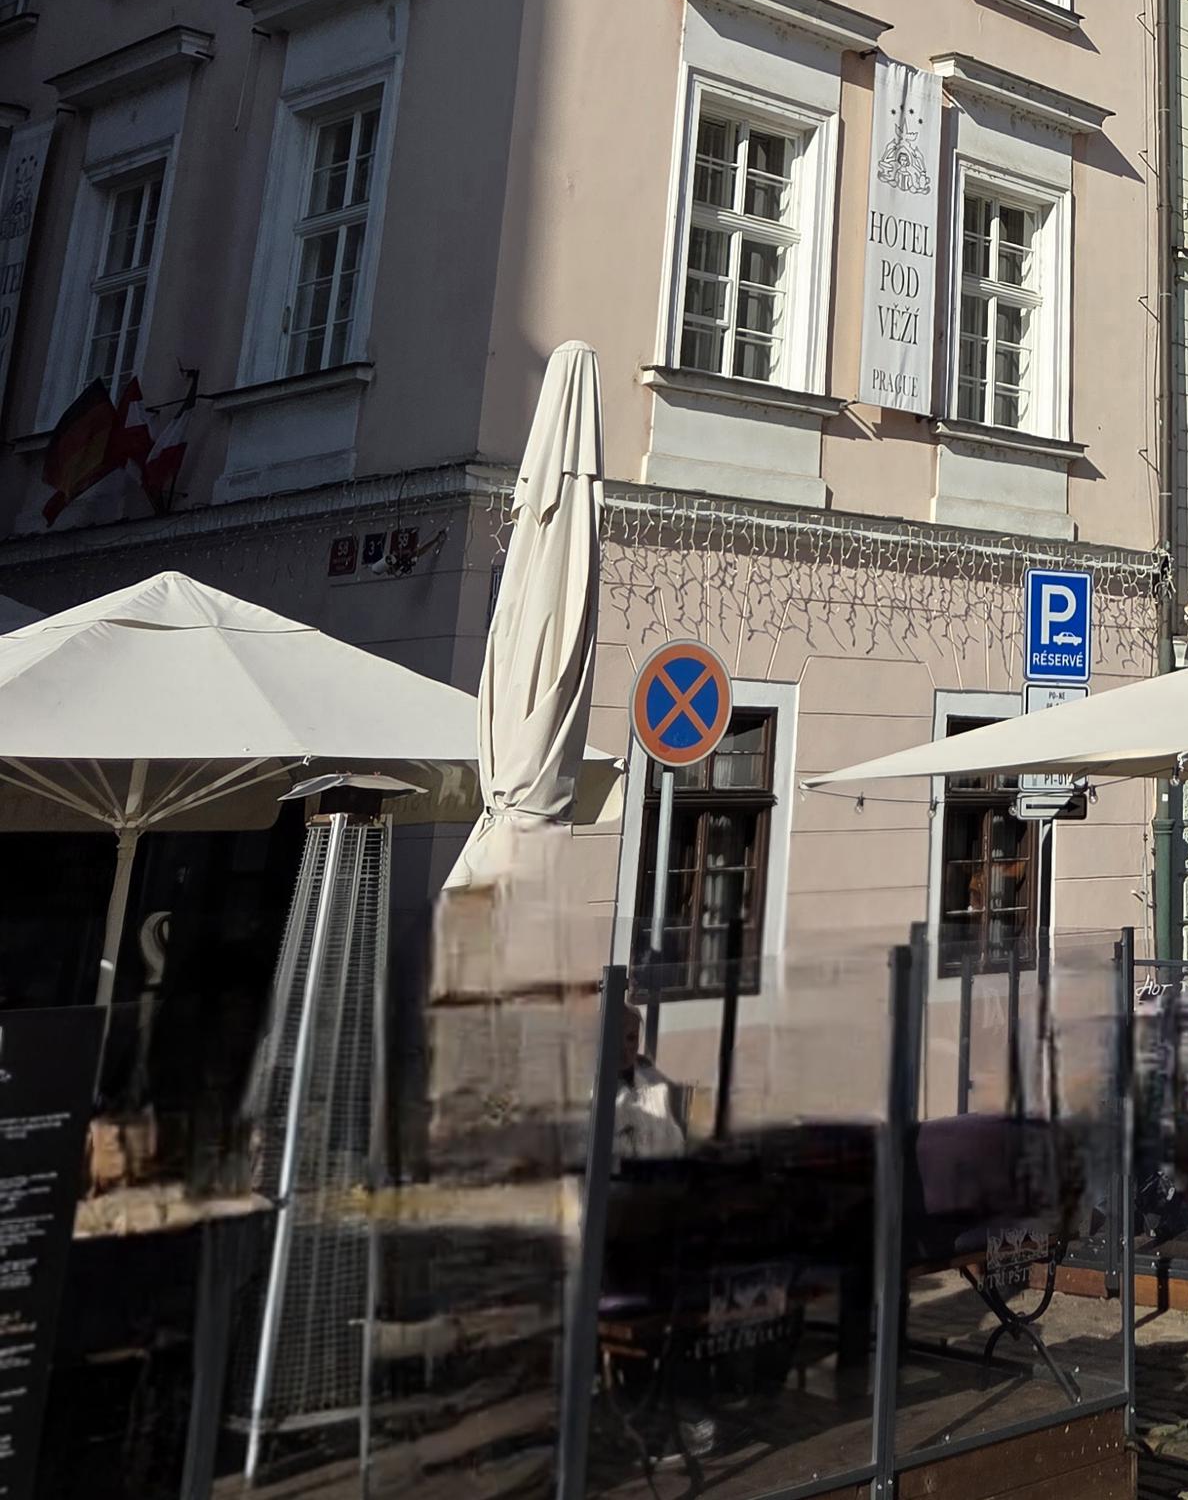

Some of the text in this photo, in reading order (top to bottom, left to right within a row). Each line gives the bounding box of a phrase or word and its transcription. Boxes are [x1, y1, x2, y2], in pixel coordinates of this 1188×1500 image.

[868, 210, 934, 258] HOTEL
[879, 259, 920, 299] POD
[877, 302, 920, 346] VĚŽÍ
[872, 368, 919, 398] PRAGUE
[1040, 583, 1077, 645] P
[1032, 650, 1083, 668] RÉSERVÉ
[1135, 973, 1173, 997] HOT
